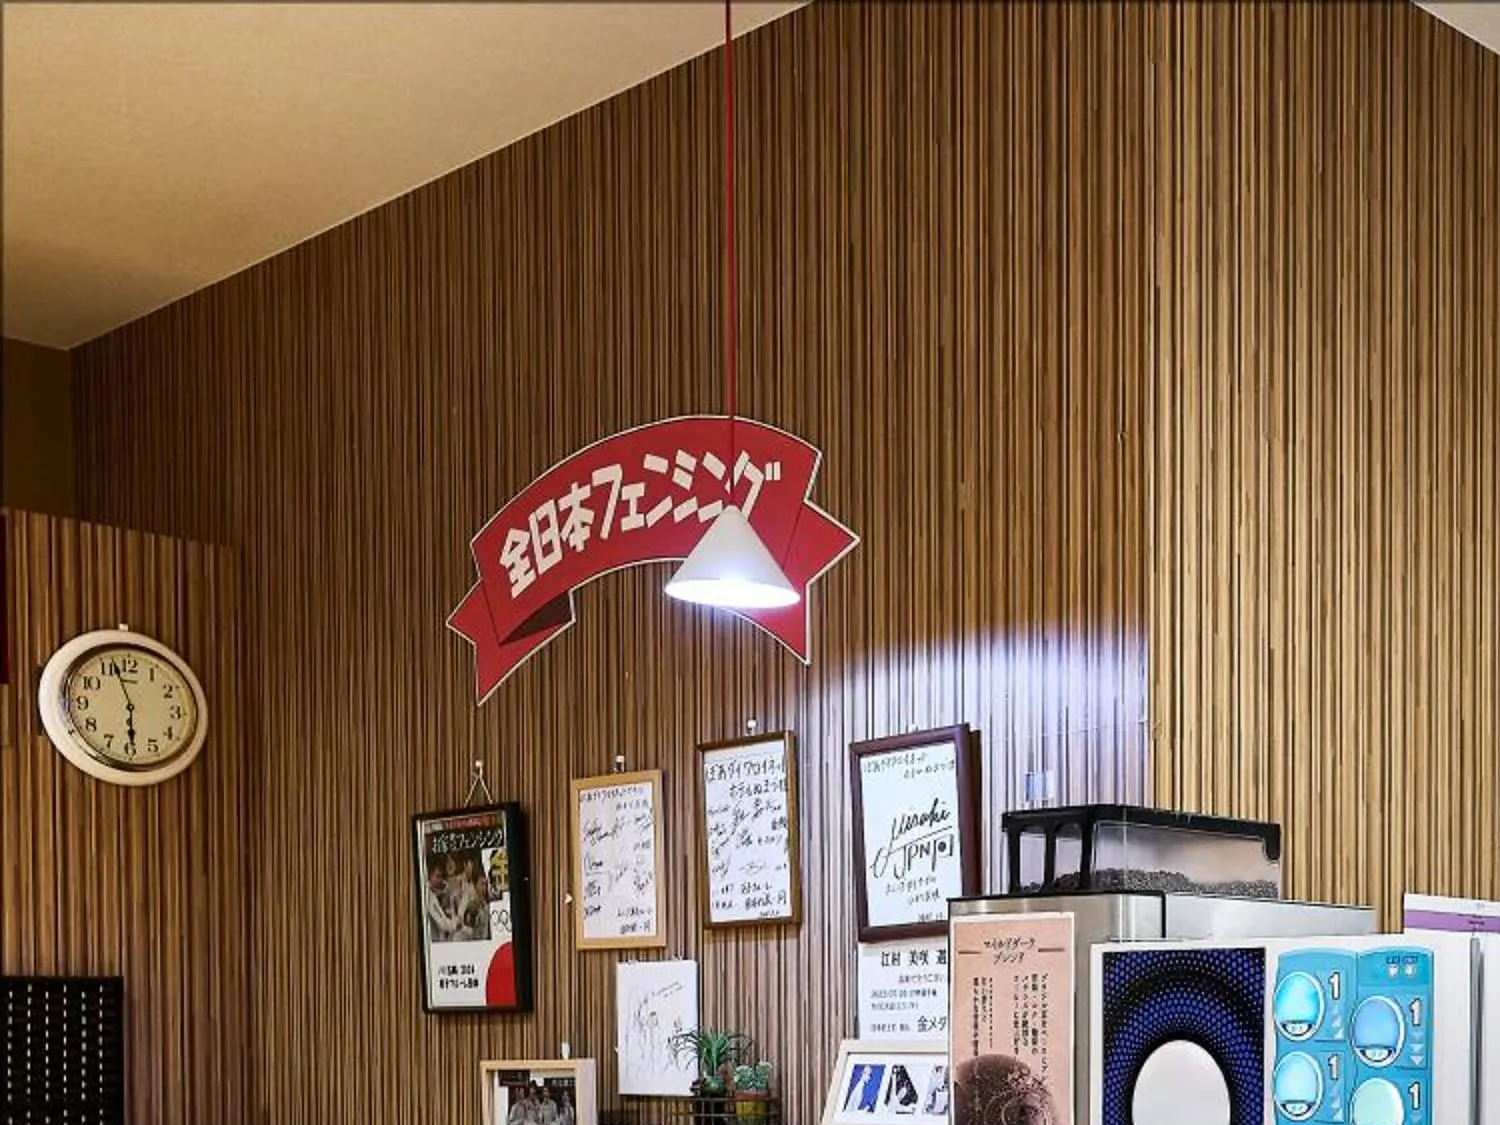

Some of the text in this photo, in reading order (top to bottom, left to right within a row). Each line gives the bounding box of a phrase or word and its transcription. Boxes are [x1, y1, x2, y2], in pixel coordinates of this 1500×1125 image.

[499, 448, 781, 600] 全日本フェンシング
[122, 659, 138, 673] 12
[149, 668, 155, 681] 1
[83, 677, 101, 690] 10
[163, 685, 174, 698] 2
[76, 697, 88, 710] 9
[170, 705, 180, 720] 3
[86, 719, 97, 731] 8
[163, 726, 173, 740] 4
[104, 735, 114, 748] 7
[148, 739, 158, 752] 5
[124, 742, 136, 756] 6
[1328, 971, 1341, 1000] 1
[1410, 998, 1421, 1027] 1
[1328, 1052, 1339, 1080] 1
[1409, 1081, 1421, 1110] 1
